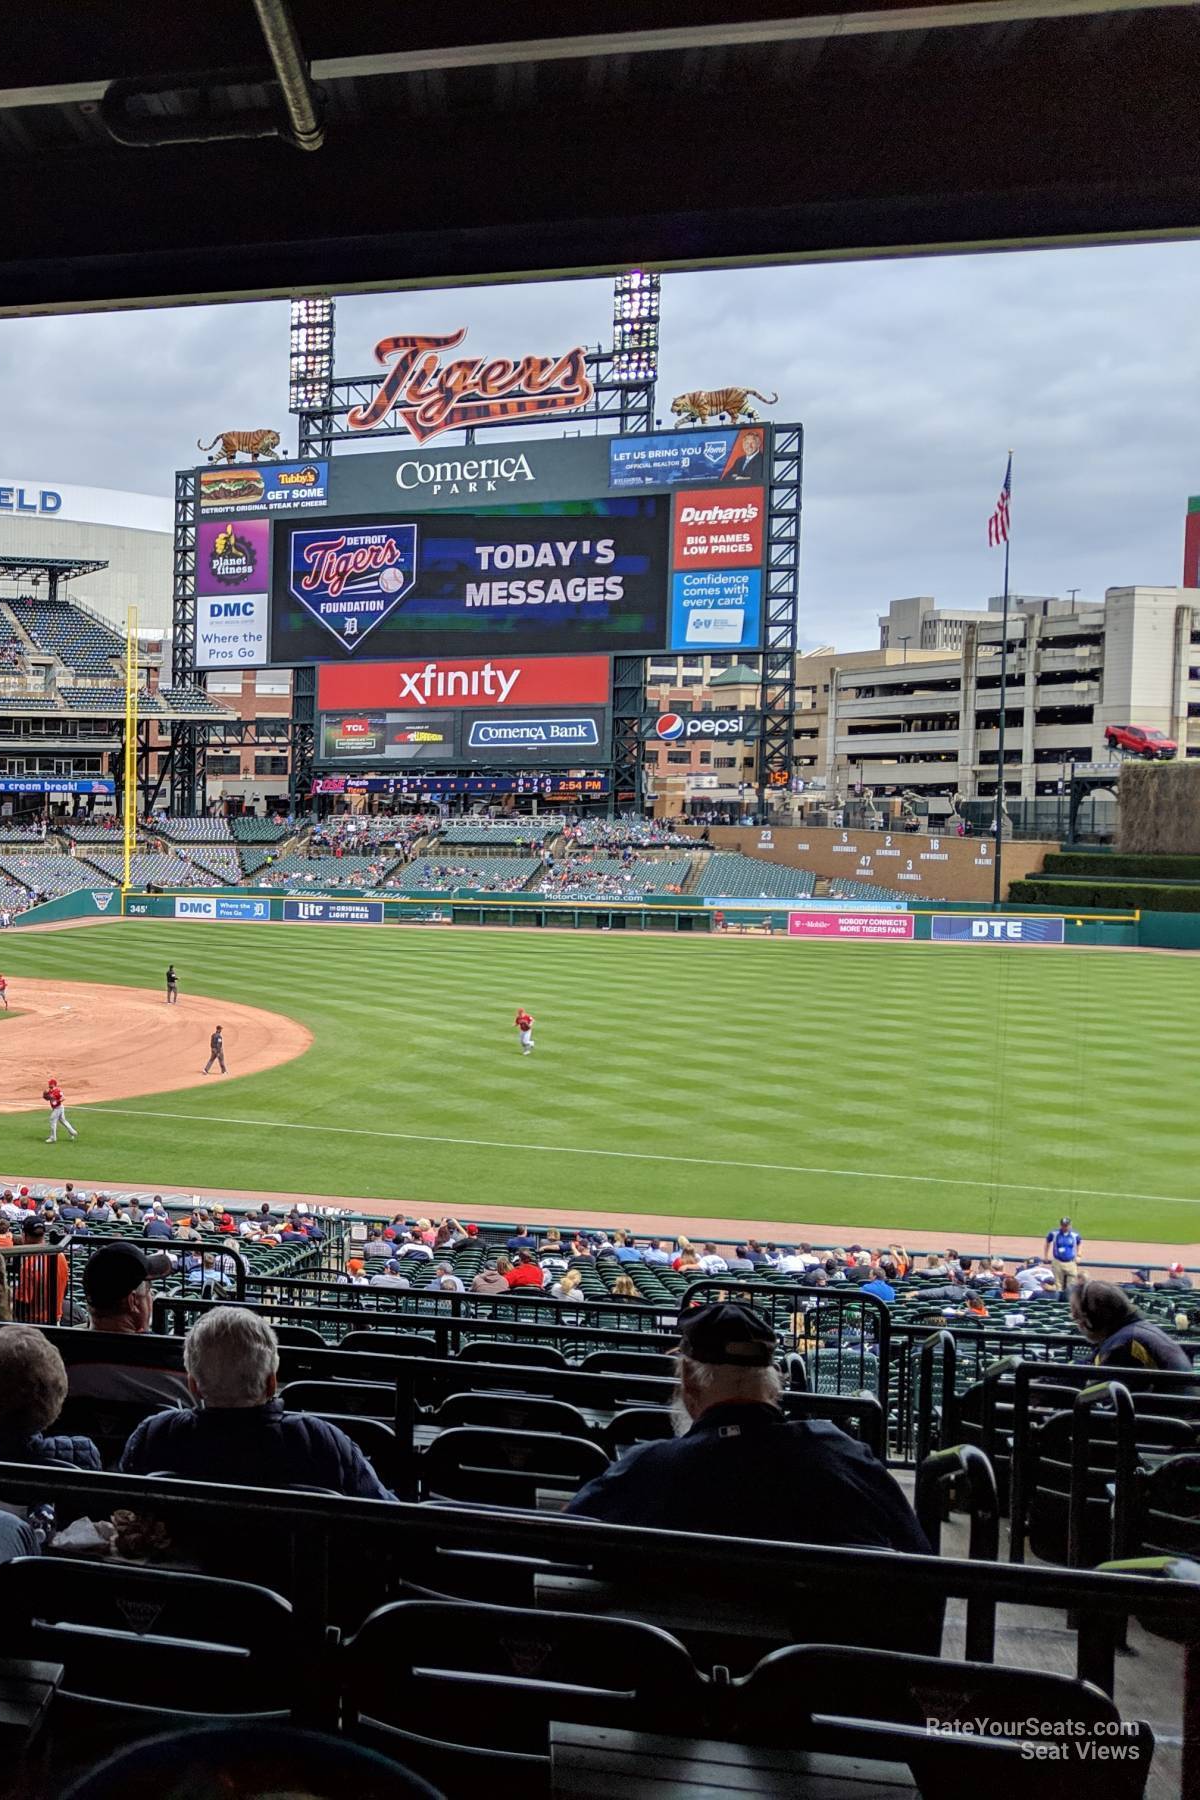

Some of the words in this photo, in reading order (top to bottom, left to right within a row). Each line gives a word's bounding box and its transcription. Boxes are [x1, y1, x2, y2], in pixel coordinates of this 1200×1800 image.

[347, 327, 594, 446] Tigers
[614, 452, 631, 461] LET
[633, 451, 647, 460] US
[650, 449, 678, 458] BRING
[682, 447, 702, 456] YOU
[278, 471, 316, 486] Tubby's
[433, 480, 497, 495] PARK
[267, 491, 289, 500] GET
[292, 488, 324, 498] SOME
[201, 506, 235, 514] DETROIT'S
[236, 504, 268, 512] ORIGINAL
[269, 502, 292, 510] STEAK
[301, 499, 327, 507] CHEESE
[680, 503, 759, 523] Dunham's
[346, 534, 388, 546] DETROIT
[686, 536, 707, 545] BIG
[709, 533, 750, 543] NAMES
[475, 539, 616, 571] TODAY'S
[683, 545, 709, 555] LOW
[711, 543, 753, 554] PRICES
[212, 556, 246, 569] planet
[302, 535, 401, 598] Tigers
[217, 565, 253, 575] fitness
[683, 573, 749, 585] Confidence
[465, 575, 625, 607] MESSAGES
[682, 587, 721, 596] comes
[723, 584, 749, 594] with
[320, 600, 384, 614] FOUNDATION
[682, 598, 714, 609] every
[717, 594, 746, 605] card.
[209, 601, 255, 618] DMC
[201, 633, 239, 645] Where
[242, 632, 263, 642] the
[208, 648, 233, 659] Pros
[237, 647, 255, 658] Go
[399, 662, 521, 705] xfinity
[345, 724, 365, 732] TCL
[550, 725, 587, 737] Bank
[686, 717, 743, 738] pepsi
[44, 782, 78, 790] break!
[311, 779, 346, 794] ROSE
[559, 781, 582, 790] 2:54
[585, 781, 601, 789] PM
[761, 831, 772, 840] 23
[842, 832, 848, 843] 5
[885, 836, 892, 846] 2
[930, 839, 939, 850] 16
[980, 843, 987, 854] 6
[860, 856, 871, 866] 47
[907, 860, 913, 870] 3
[130, 905, 148, 913] 345'
[179, 902, 212, 914] DMC
[297, 902, 324, 918] Lite
[329, 910, 349, 918] LIGHT
[350, 911, 369, 919] BEER
[838, 918, 867, 926] NOBODY
[869, 919, 908, 927] CONNECTS
[840, 925, 862, 933] MORE
[863, 926, 888, 934] TIGERS
[888, 926, 906, 934] FANS
[972, 920, 1022, 938] DTE
